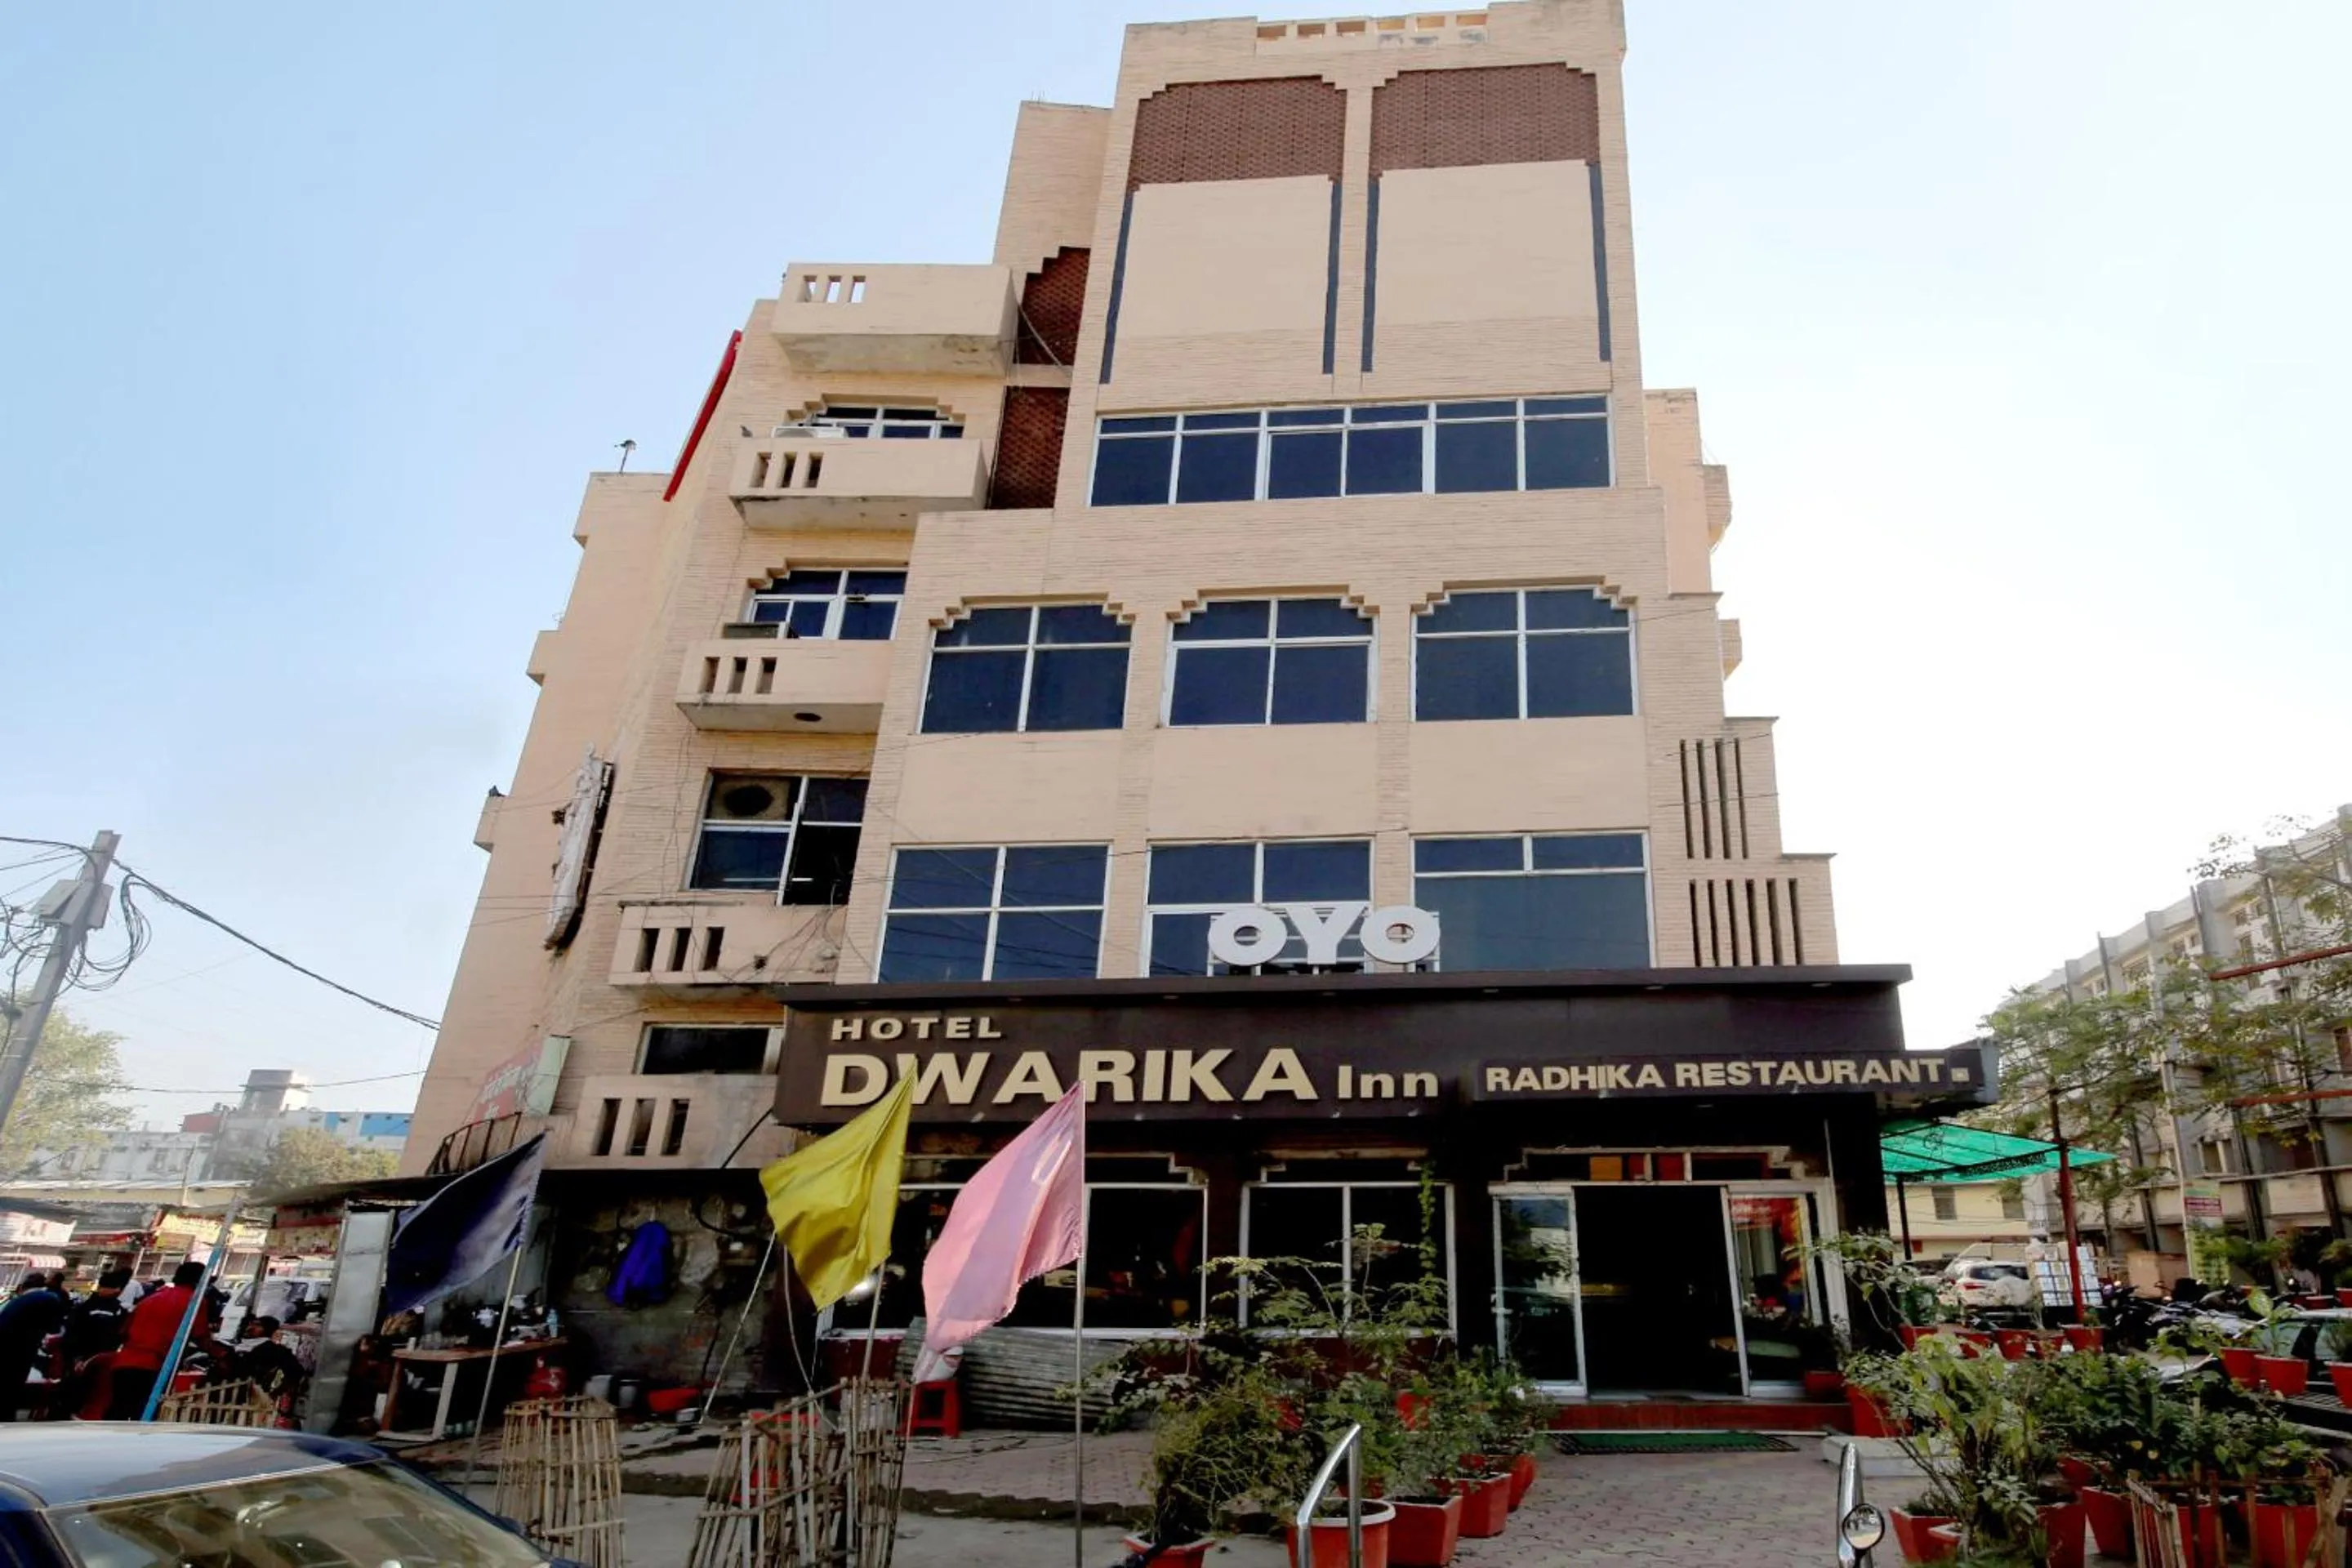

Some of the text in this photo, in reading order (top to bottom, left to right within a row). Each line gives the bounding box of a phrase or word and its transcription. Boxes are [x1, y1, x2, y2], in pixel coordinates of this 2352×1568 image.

[1209, 904, 1440, 966] OYO
[831, 1016, 1003, 1040] HOTEL
[820, 1049, 1439, 1107] DWARIKA Inn
[1486, 1058, 1946, 1093] RADHIKA RESTAURANT
